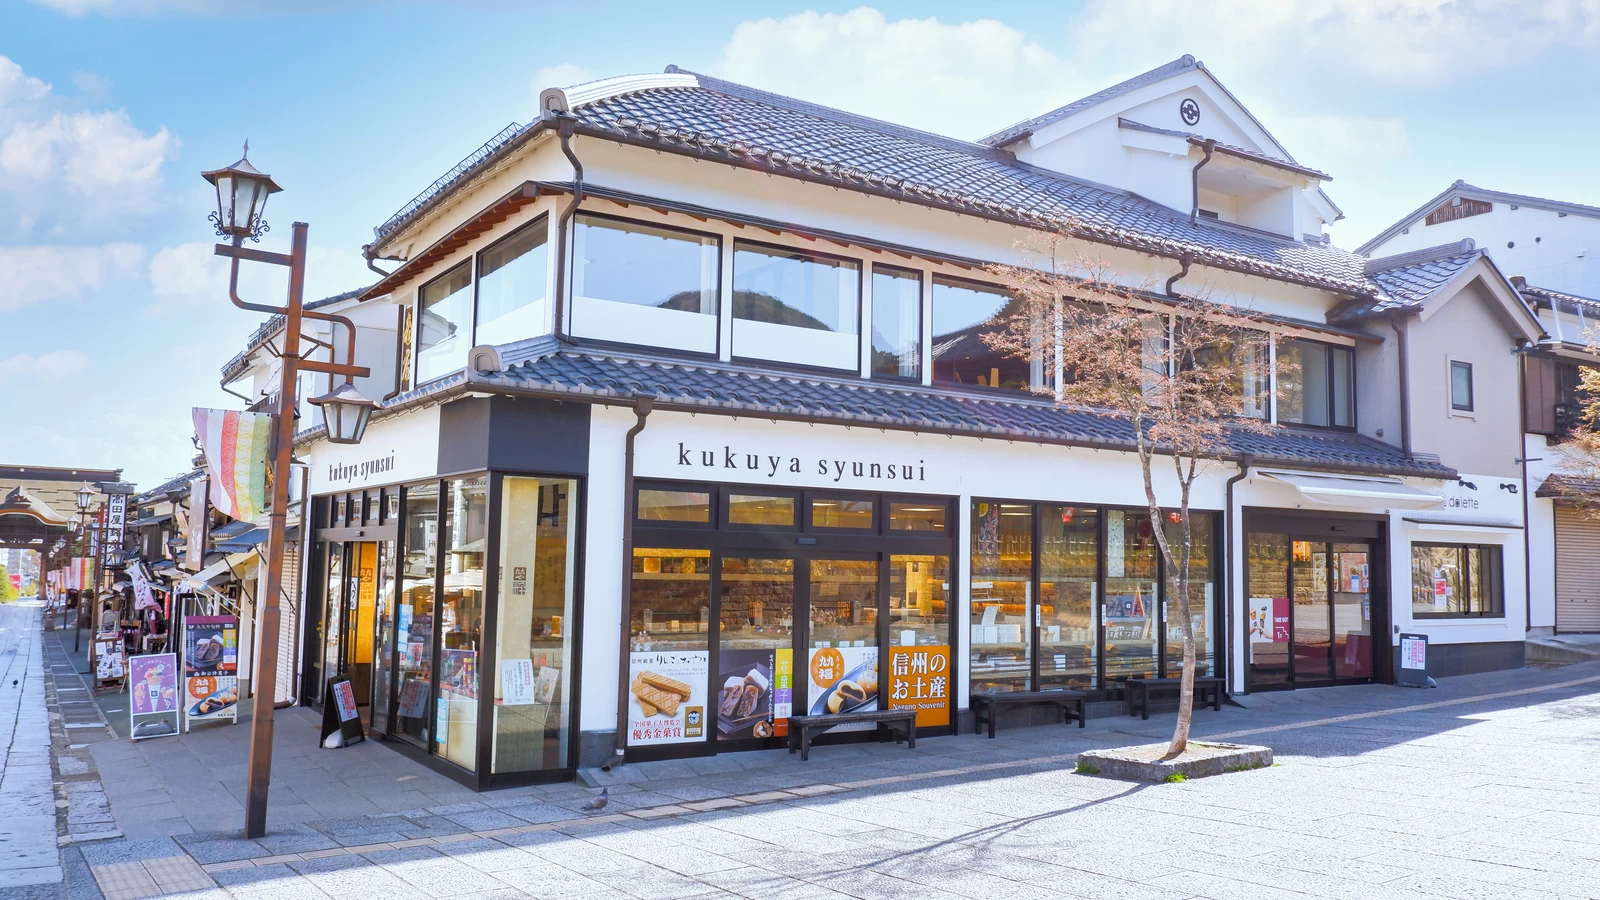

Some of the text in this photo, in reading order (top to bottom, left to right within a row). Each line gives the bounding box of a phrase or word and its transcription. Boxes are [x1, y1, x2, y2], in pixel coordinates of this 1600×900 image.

[328, 449, 395, 483] kukuya syunsui
[677, 442, 925, 482] kukuya syunsui
[1449, 496, 1479, 509] dolette
[892, 652, 946, 676] 信州の
[892, 676, 946, 700] お土産
[918, 701, 945, 709] Souvenir
[632, 727, 682, 740] 優秀金菓賞
